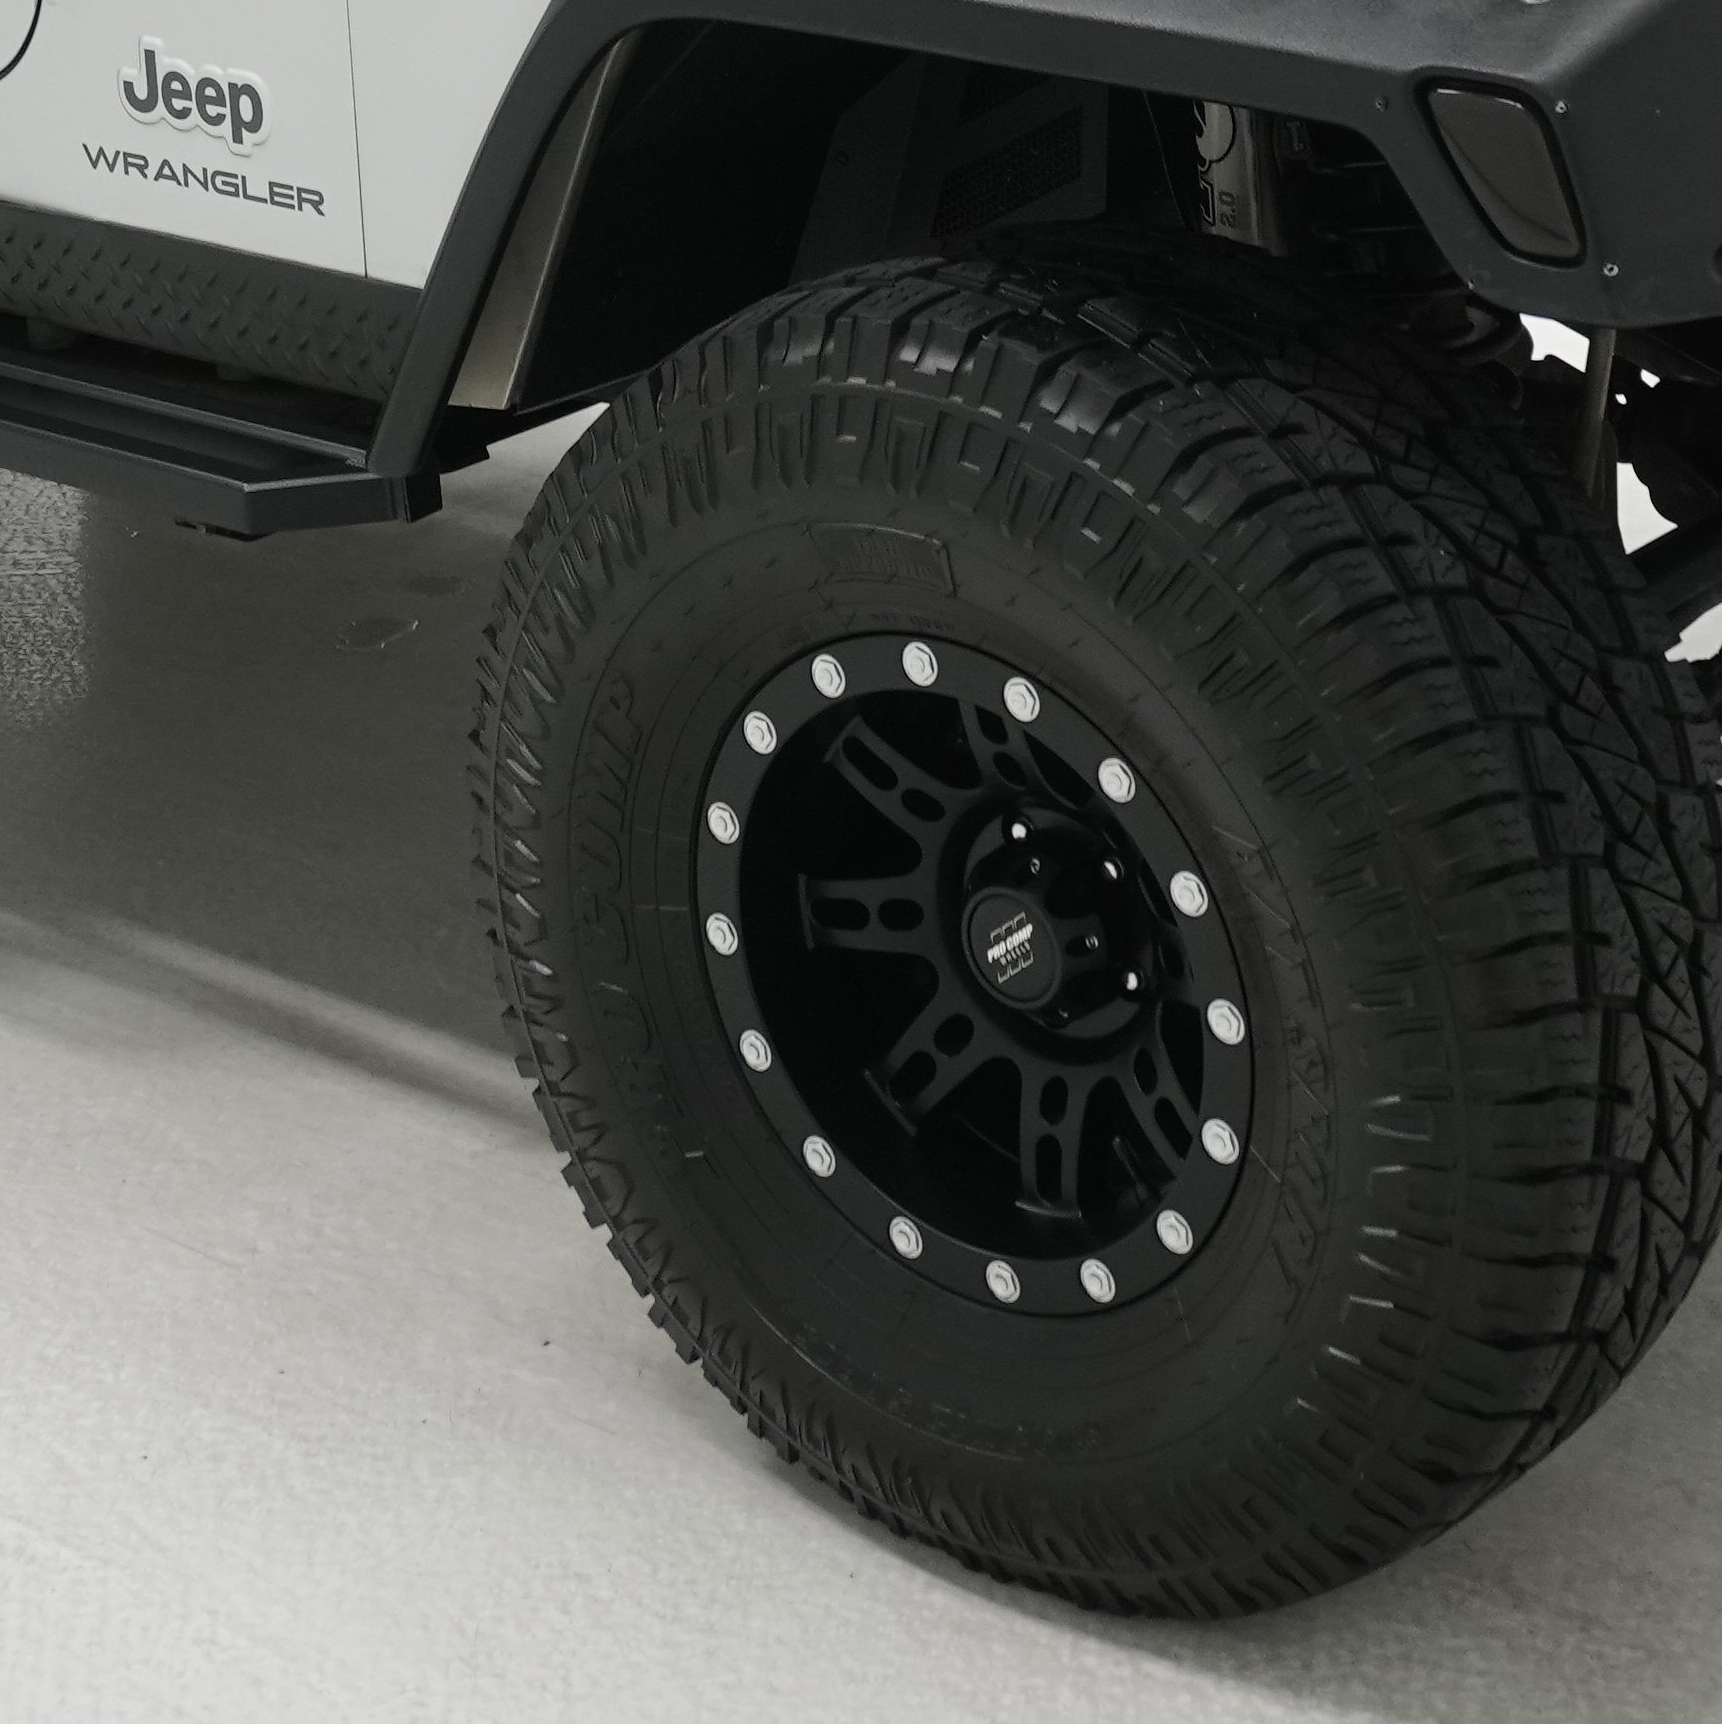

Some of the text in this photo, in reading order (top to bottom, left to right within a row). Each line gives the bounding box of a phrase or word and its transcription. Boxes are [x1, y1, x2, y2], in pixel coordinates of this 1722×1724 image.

[122, 49, 264, 145] Jeep
[81, 142, 326, 217] WRANGLER
[575, 665, 644, 966] COMP
[986, 923, 1033, 964] PRO COMP
